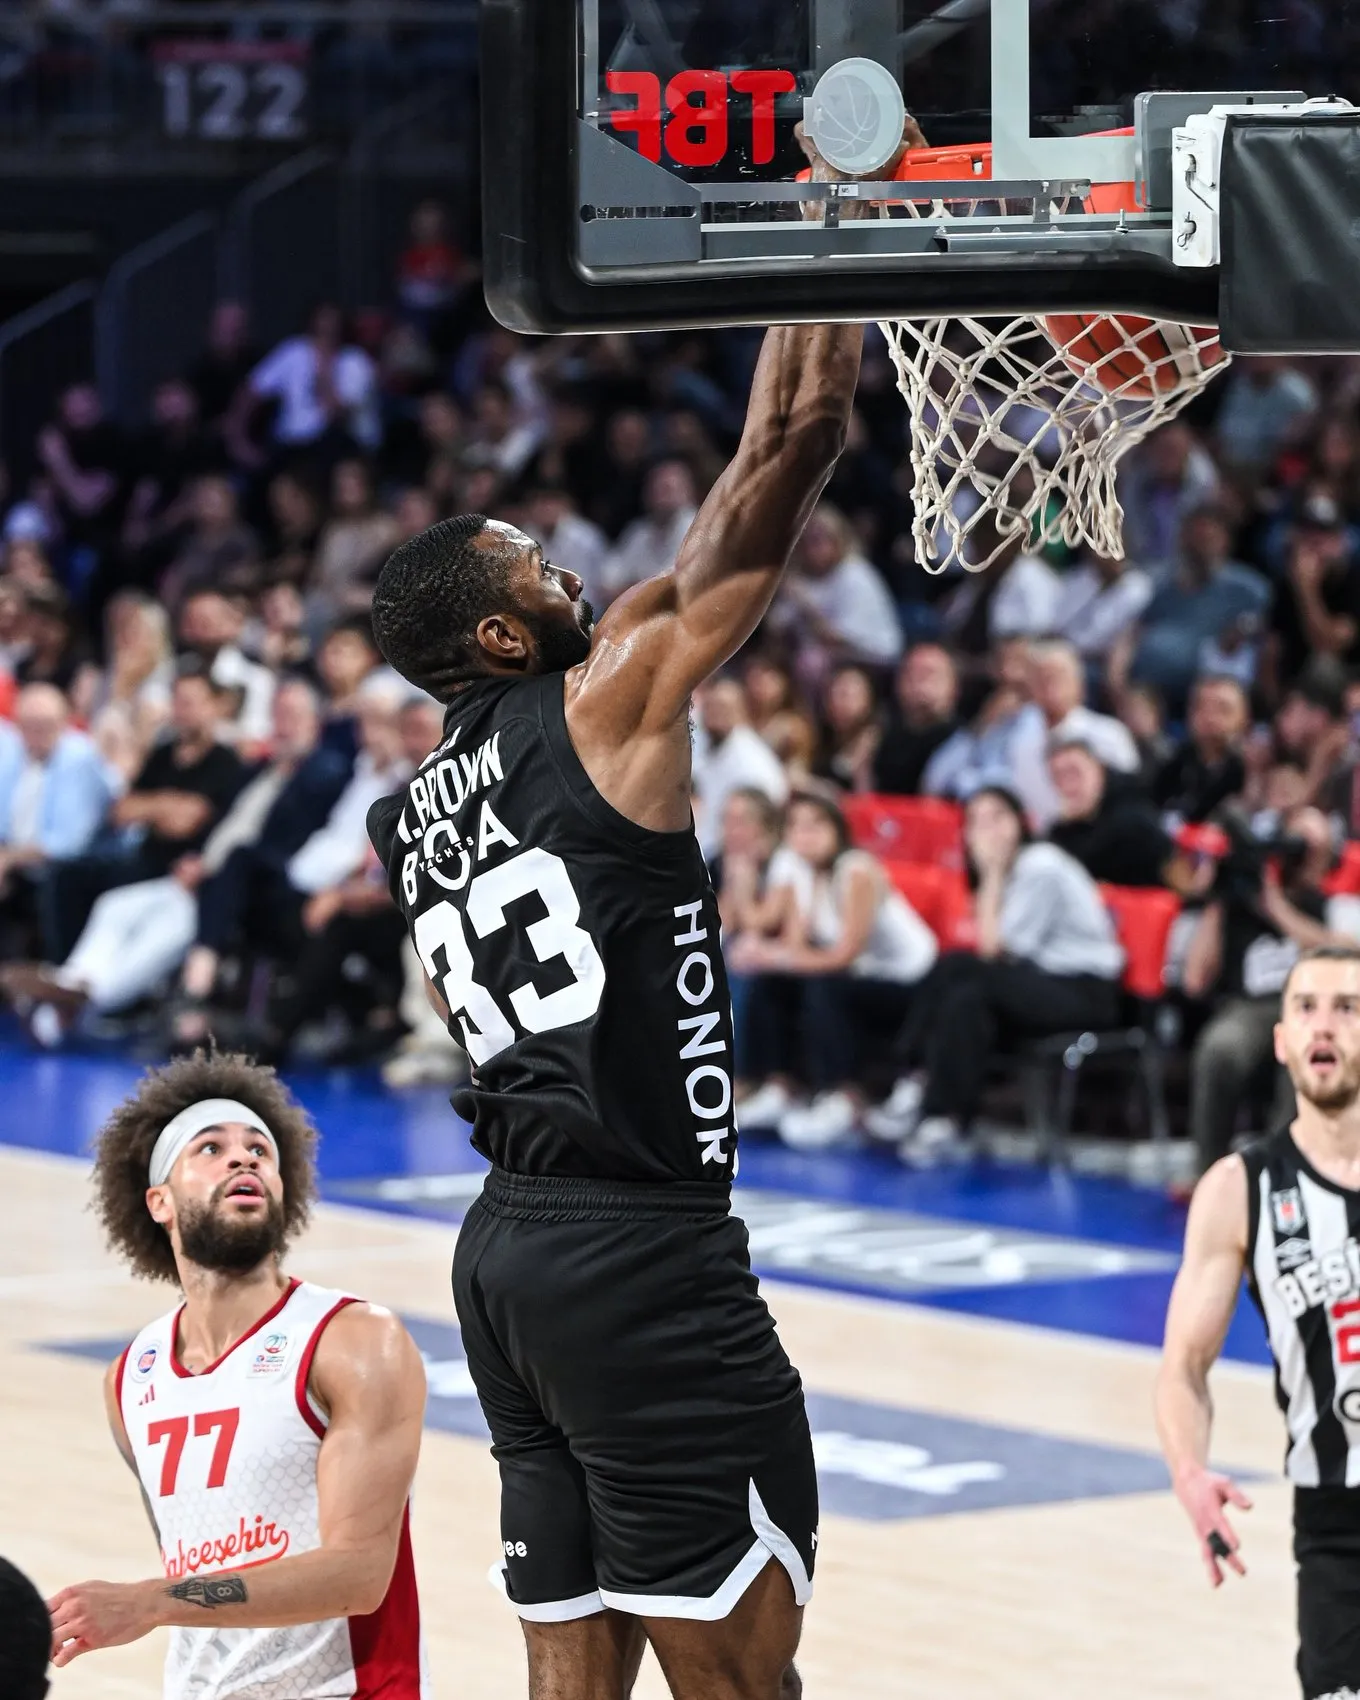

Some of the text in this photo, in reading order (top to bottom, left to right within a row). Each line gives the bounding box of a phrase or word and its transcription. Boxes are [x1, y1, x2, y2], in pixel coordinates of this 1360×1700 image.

[162, 63, 304, 140] 122
[418, 836, 475, 872] YACHTS
[414, 846, 606, 1067] 33
[673, 899, 732, 1165] HONOR
[148, 1407, 240, 1497] 77
